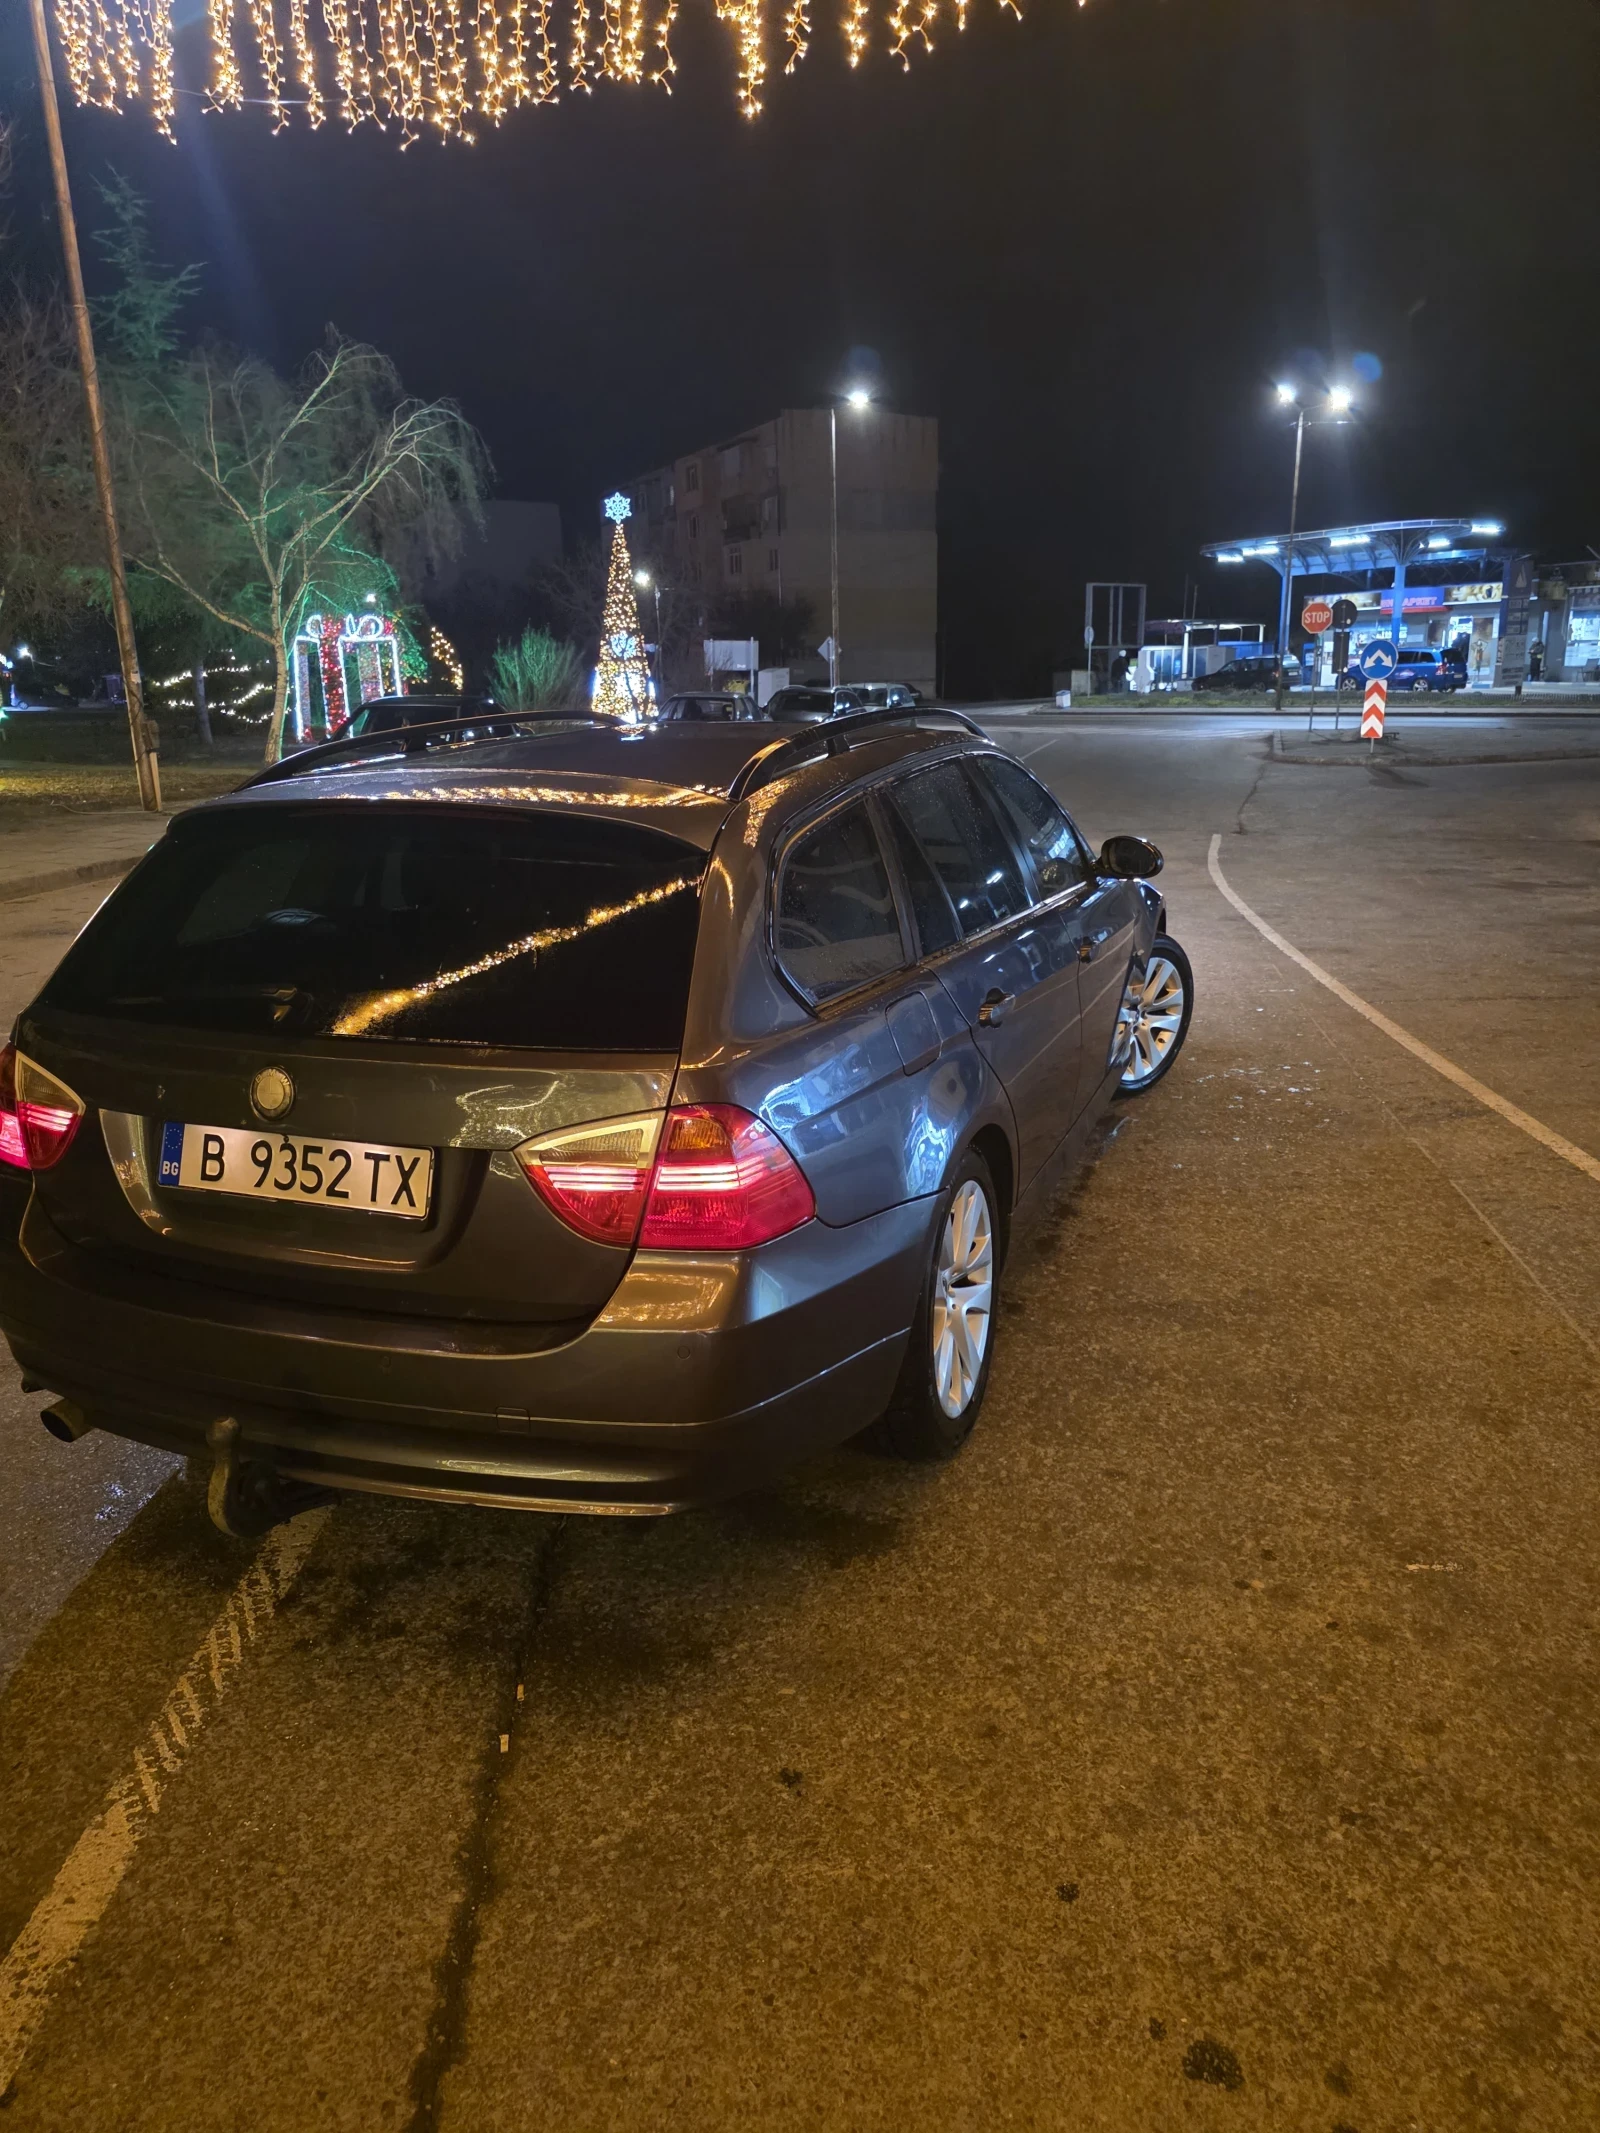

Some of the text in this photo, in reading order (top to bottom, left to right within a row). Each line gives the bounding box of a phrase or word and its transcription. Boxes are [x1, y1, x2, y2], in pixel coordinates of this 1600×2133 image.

[1304, 611, 1330, 624] STOP
[255, 1068, 290, 1086] BMW
[162, 1161, 179, 1176] BG
[200, 1133, 421, 1208] B 9352 TX
